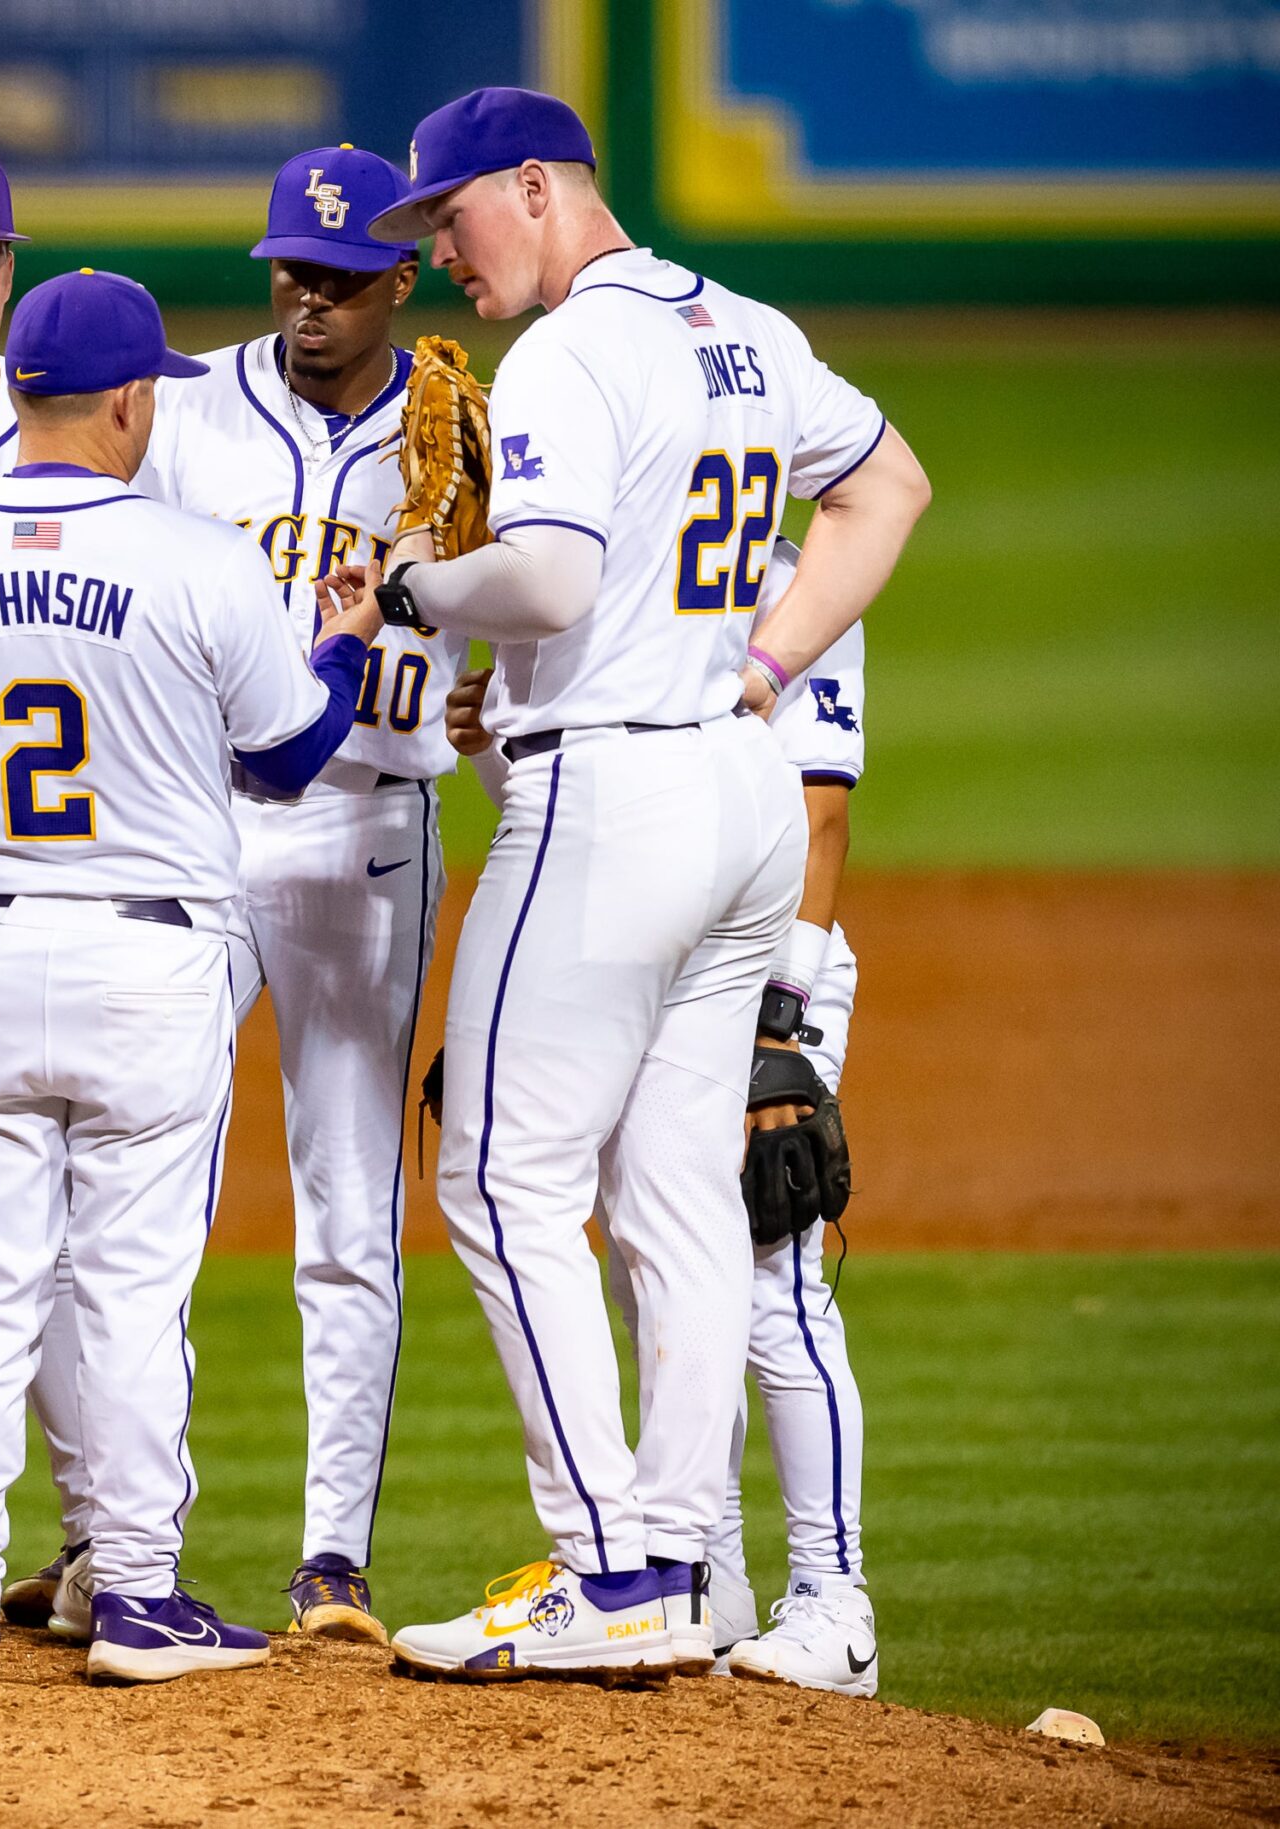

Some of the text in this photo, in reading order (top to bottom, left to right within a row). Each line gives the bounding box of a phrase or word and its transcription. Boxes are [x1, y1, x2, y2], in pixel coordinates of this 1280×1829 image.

[305, 169, 349, 229] LSU
[694, 343, 766, 400] JONES
[673, 446, 782, 616] 22
[353, 645, 432, 736] 10
[607, 1618, 650, 1640] PSALM
[497, 1650, 510, 1668] 22
